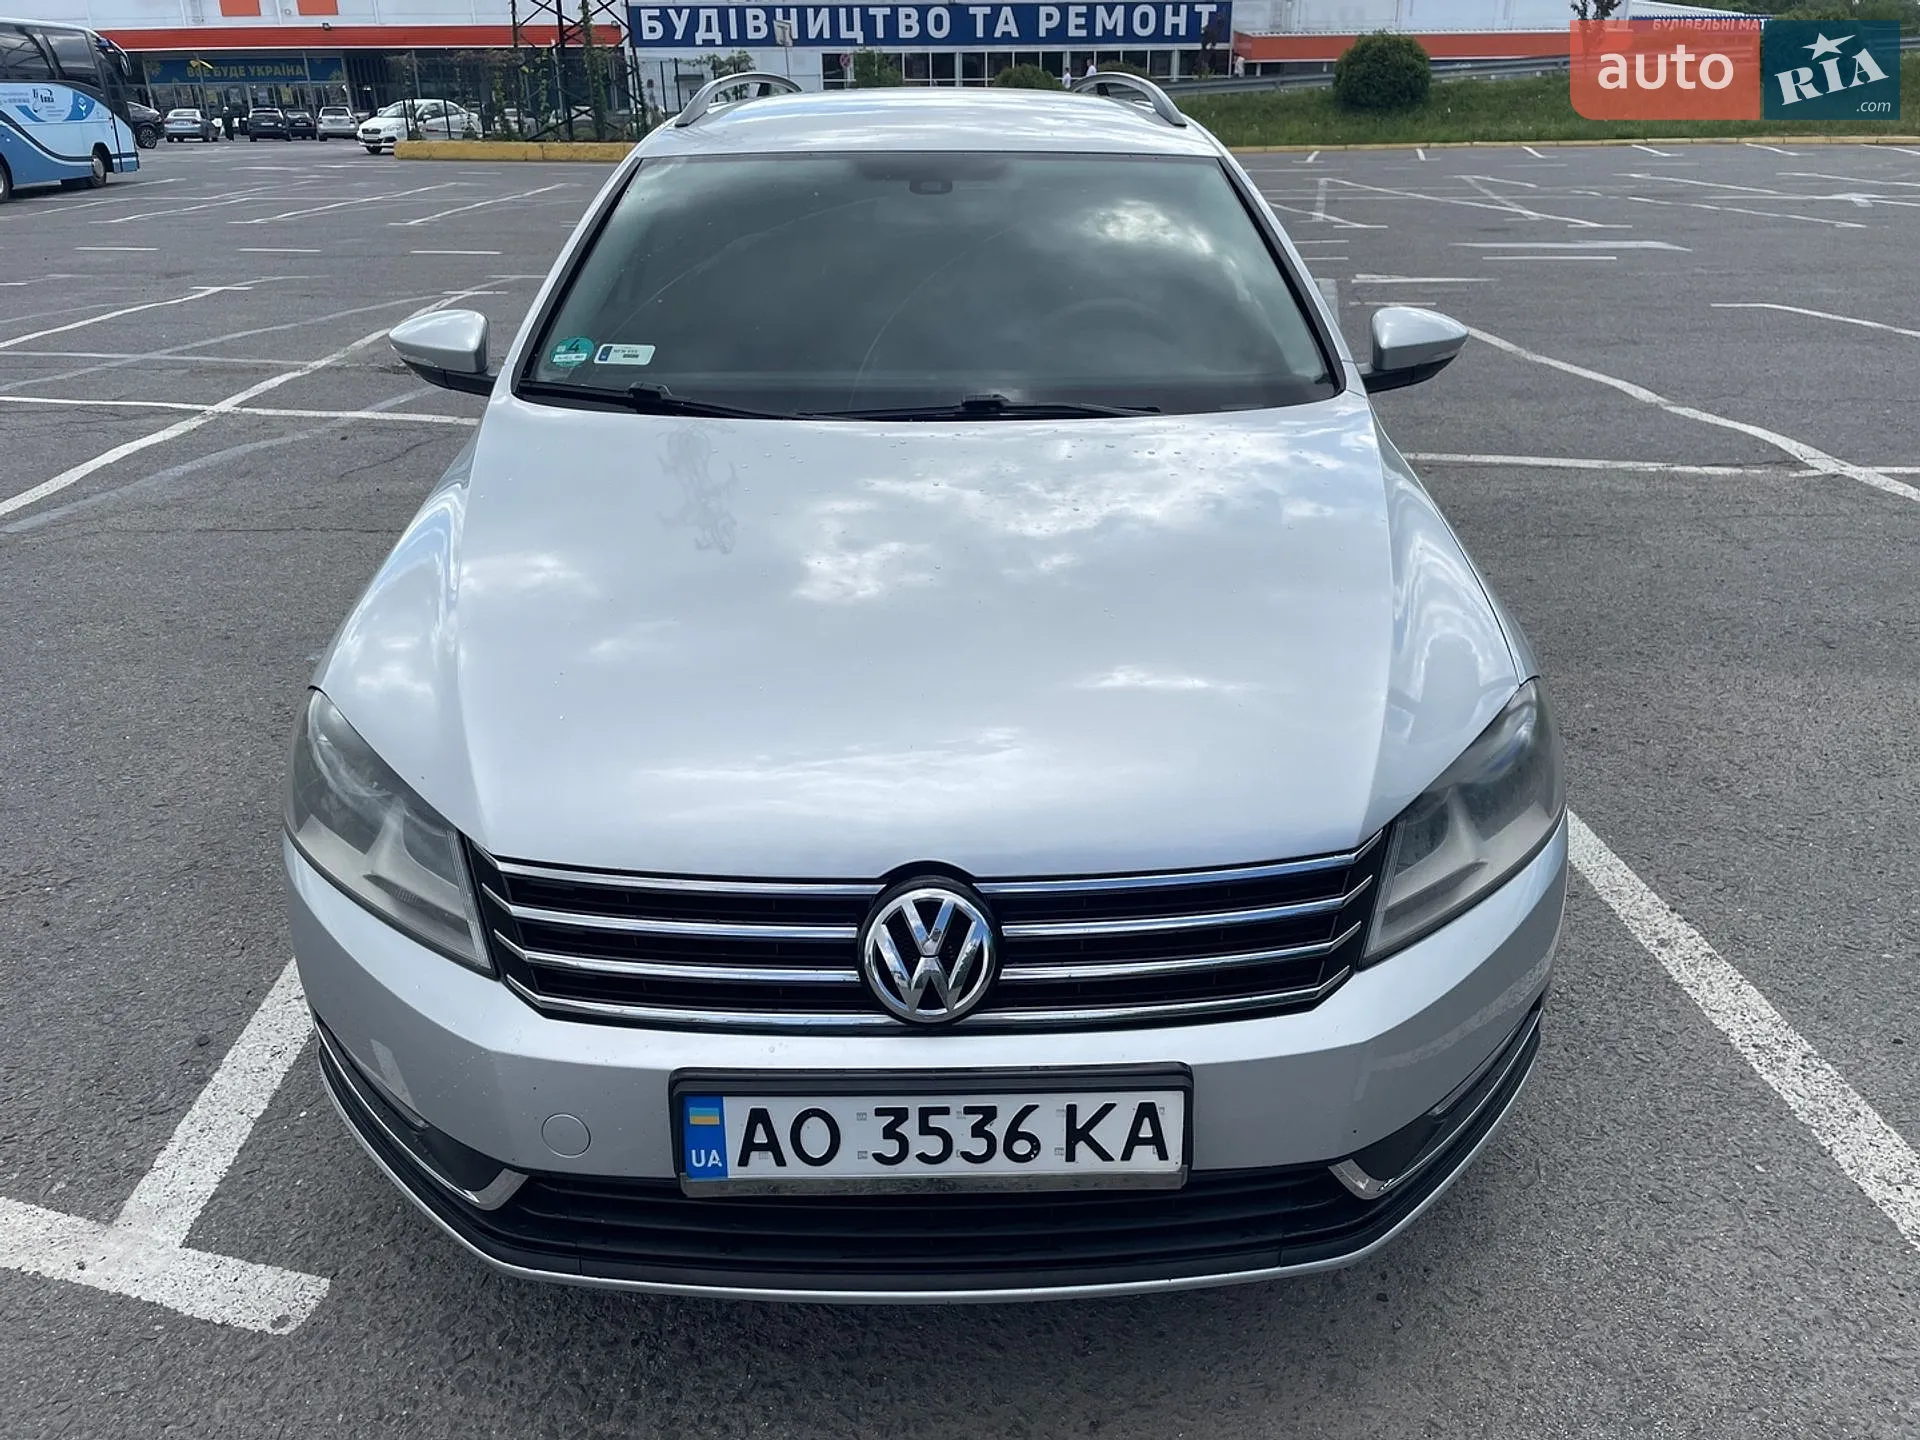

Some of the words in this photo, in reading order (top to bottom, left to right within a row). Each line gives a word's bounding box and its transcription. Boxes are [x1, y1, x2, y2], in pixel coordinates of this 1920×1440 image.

[640, 7, 951, 45] БУДІВНИЦТВО
[969, 6, 1020, 38] ТА
[1038, 4, 1217, 38] РЕМОНТ
[737, 1107, 842, 1168] AO
[871, 1104, 1042, 1166] 3536
[1064, 1101, 1170, 1163] KA
[691, 1149, 723, 1169] UA
